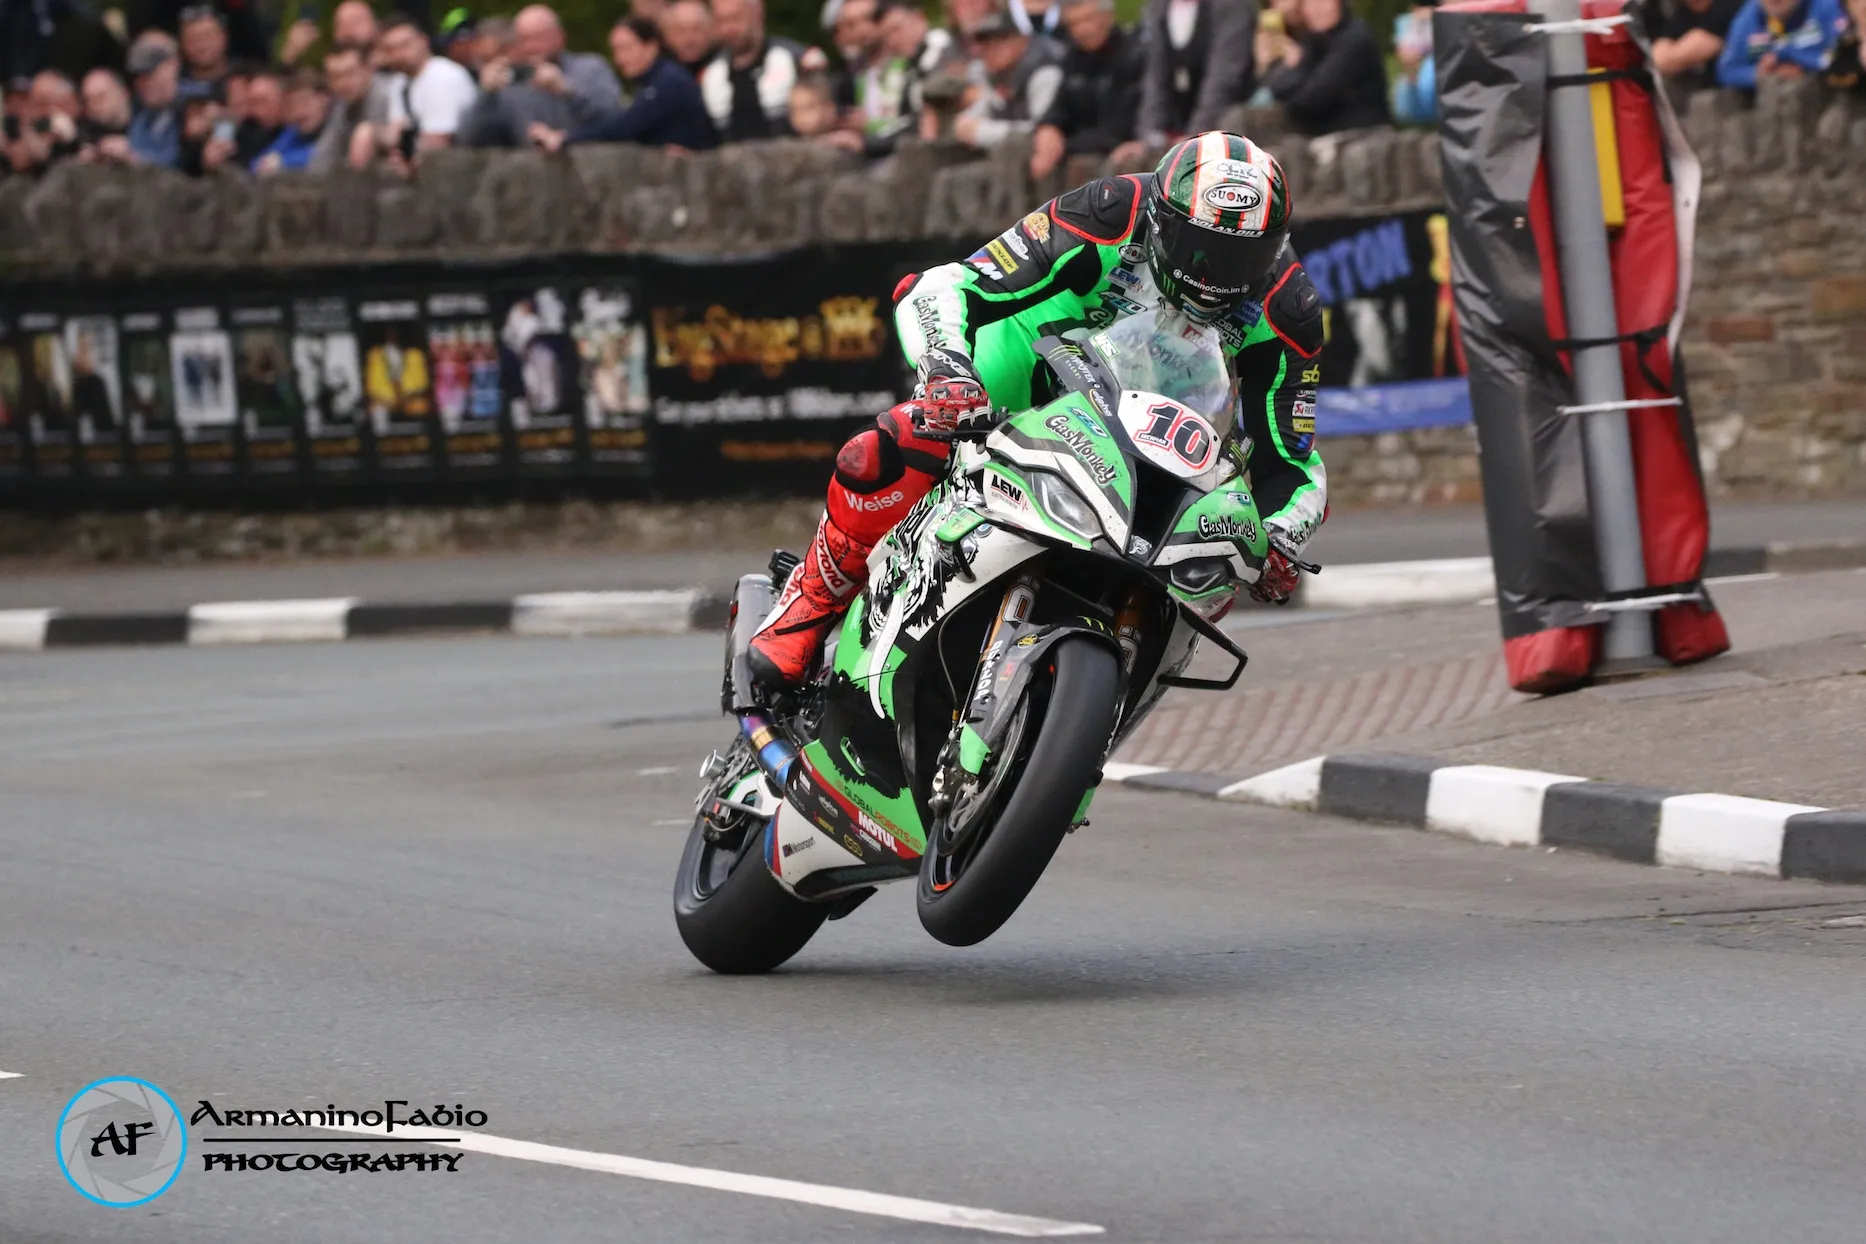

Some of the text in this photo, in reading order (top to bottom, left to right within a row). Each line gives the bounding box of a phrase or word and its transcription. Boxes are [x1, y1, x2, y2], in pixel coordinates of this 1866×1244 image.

[1210, 189, 1257, 205] SUOMY
[1183, 275, 1240, 294] CasinoCoin.im
[1044, 415, 1117, 487] GasMonkey
[1136, 402, 1213, 469] 10
[844, 489, 904, 513] Weise
[991, 474, 1022, 502] LEW
[818, 524, 847, 588] aytona
[858, 810, 898, 853] MOTUL
